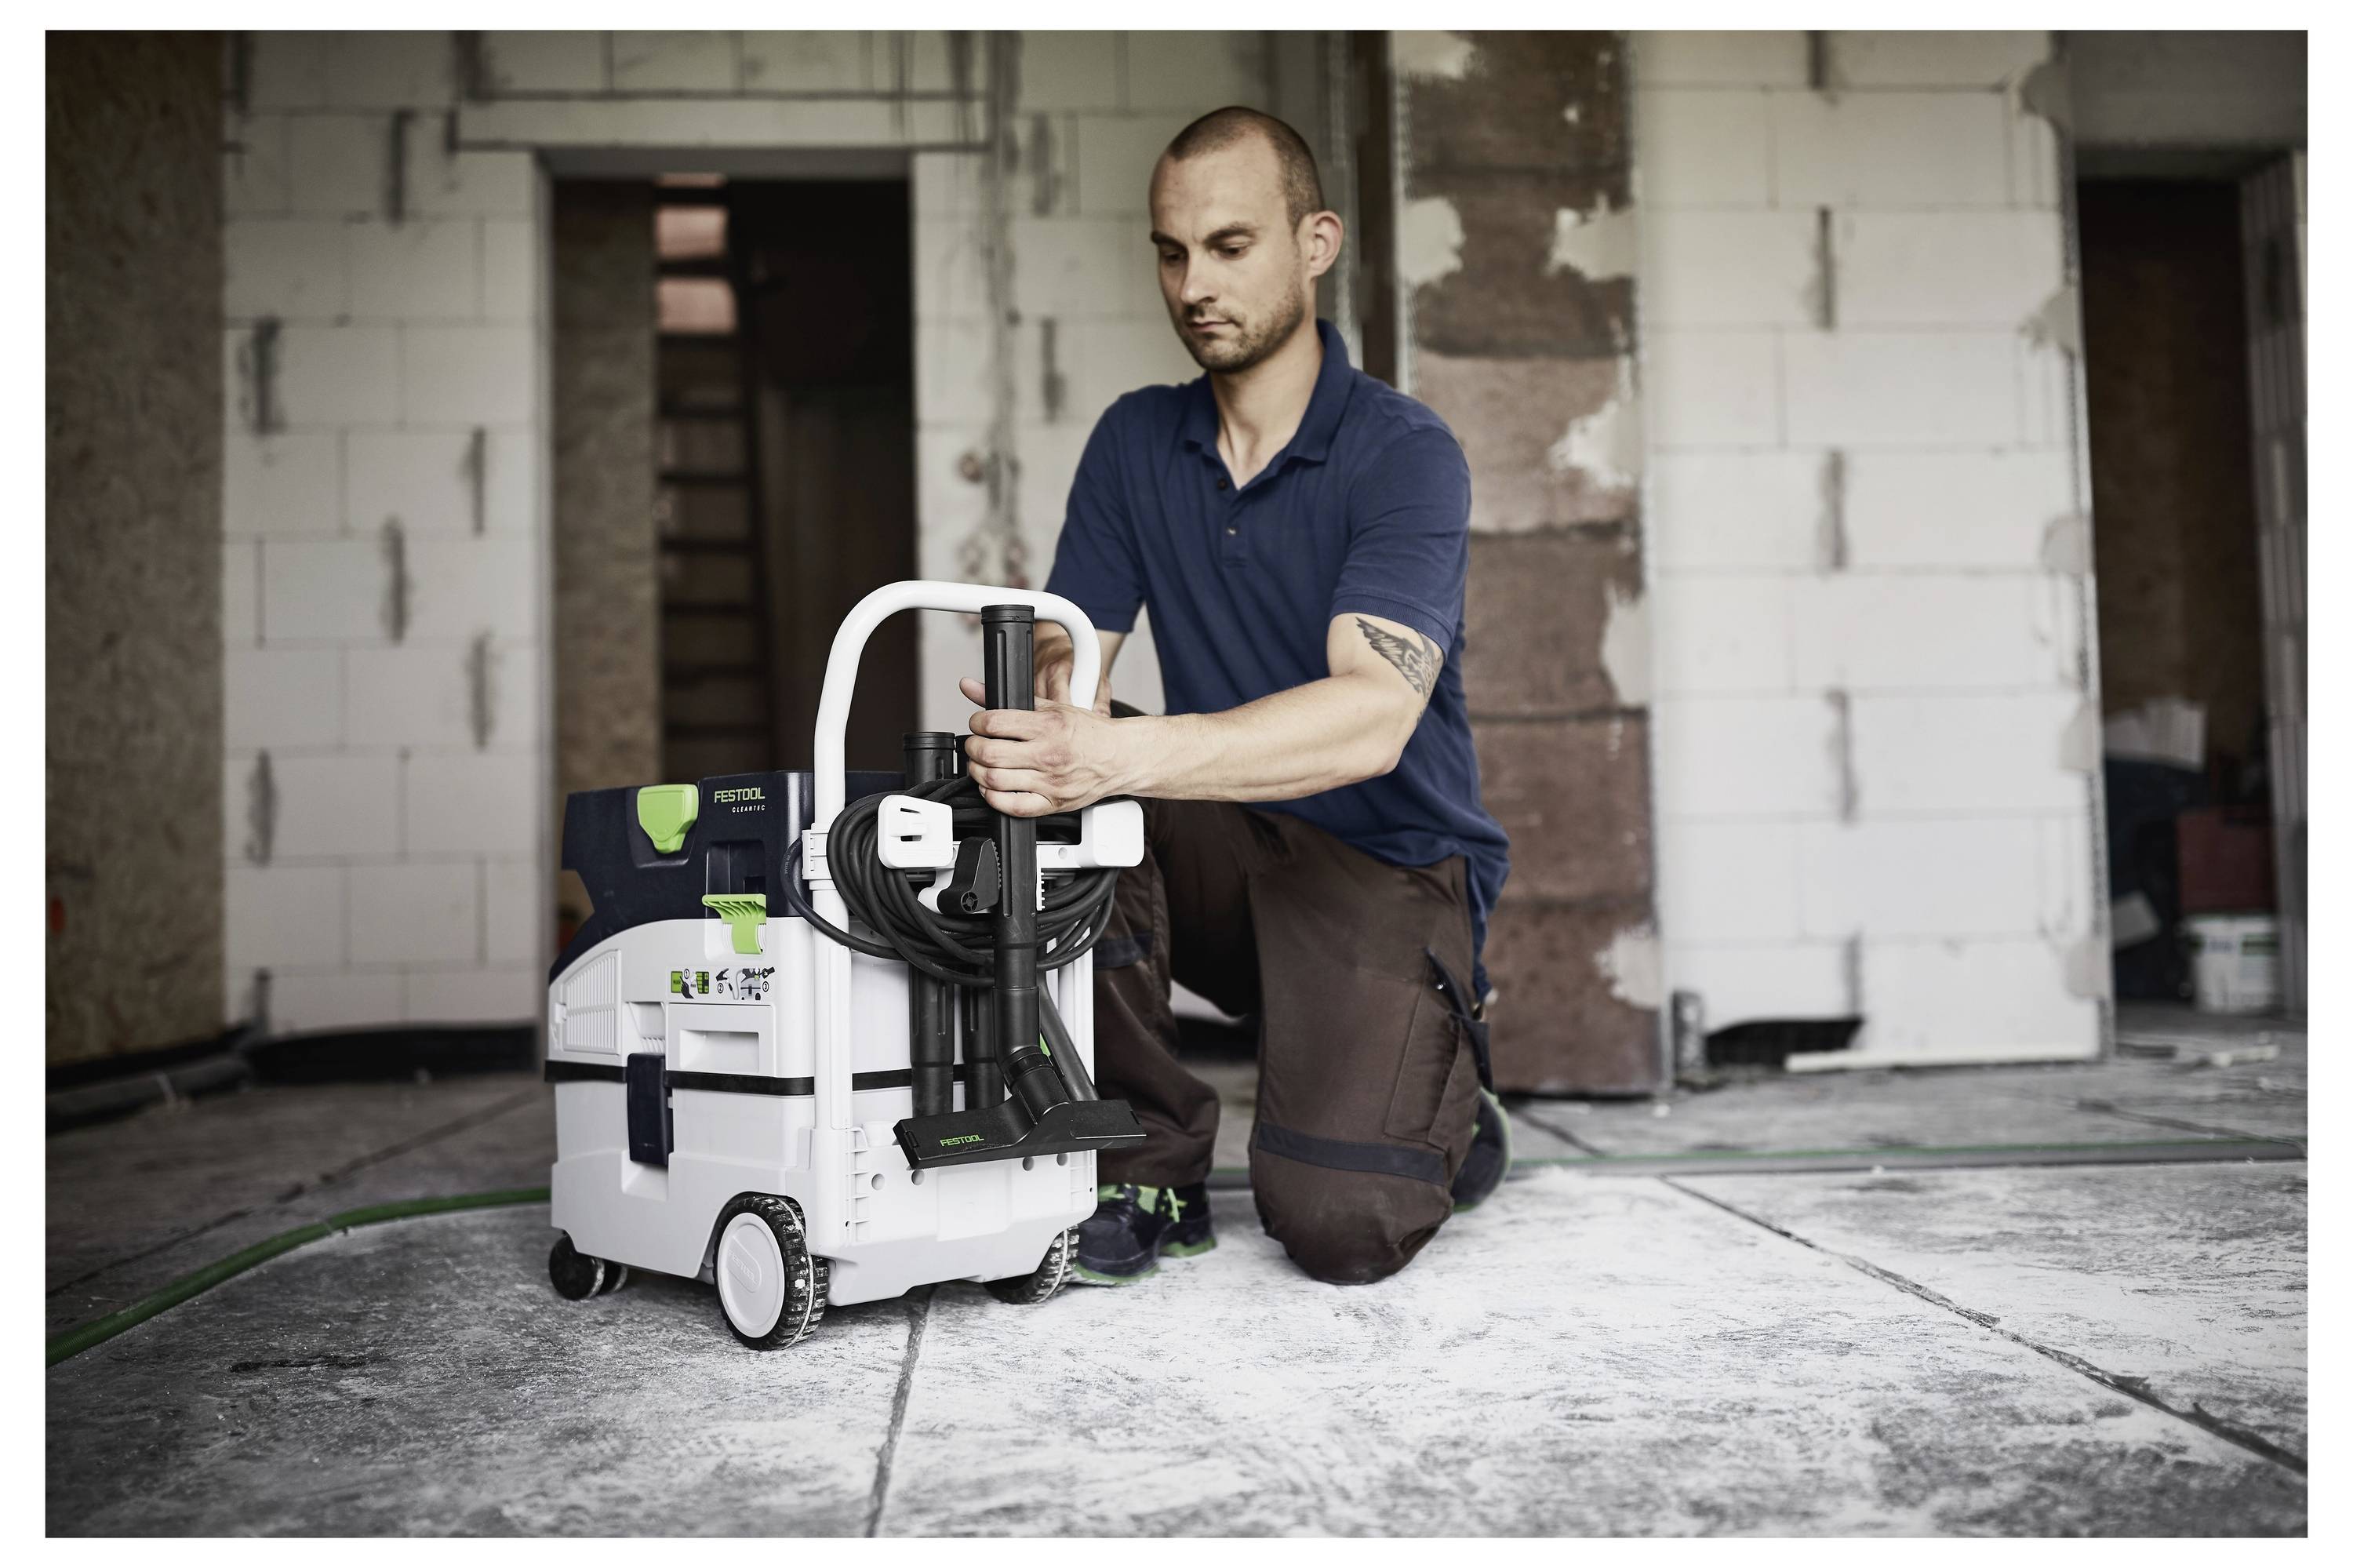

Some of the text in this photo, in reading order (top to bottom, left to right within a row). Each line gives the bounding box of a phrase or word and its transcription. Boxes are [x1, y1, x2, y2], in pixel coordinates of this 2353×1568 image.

[715, 787, 766, 803] FESTOOL
[732, 805, 766, 813] CLEANTEC
[940, 1134, 984, 1147] FESTOOL
